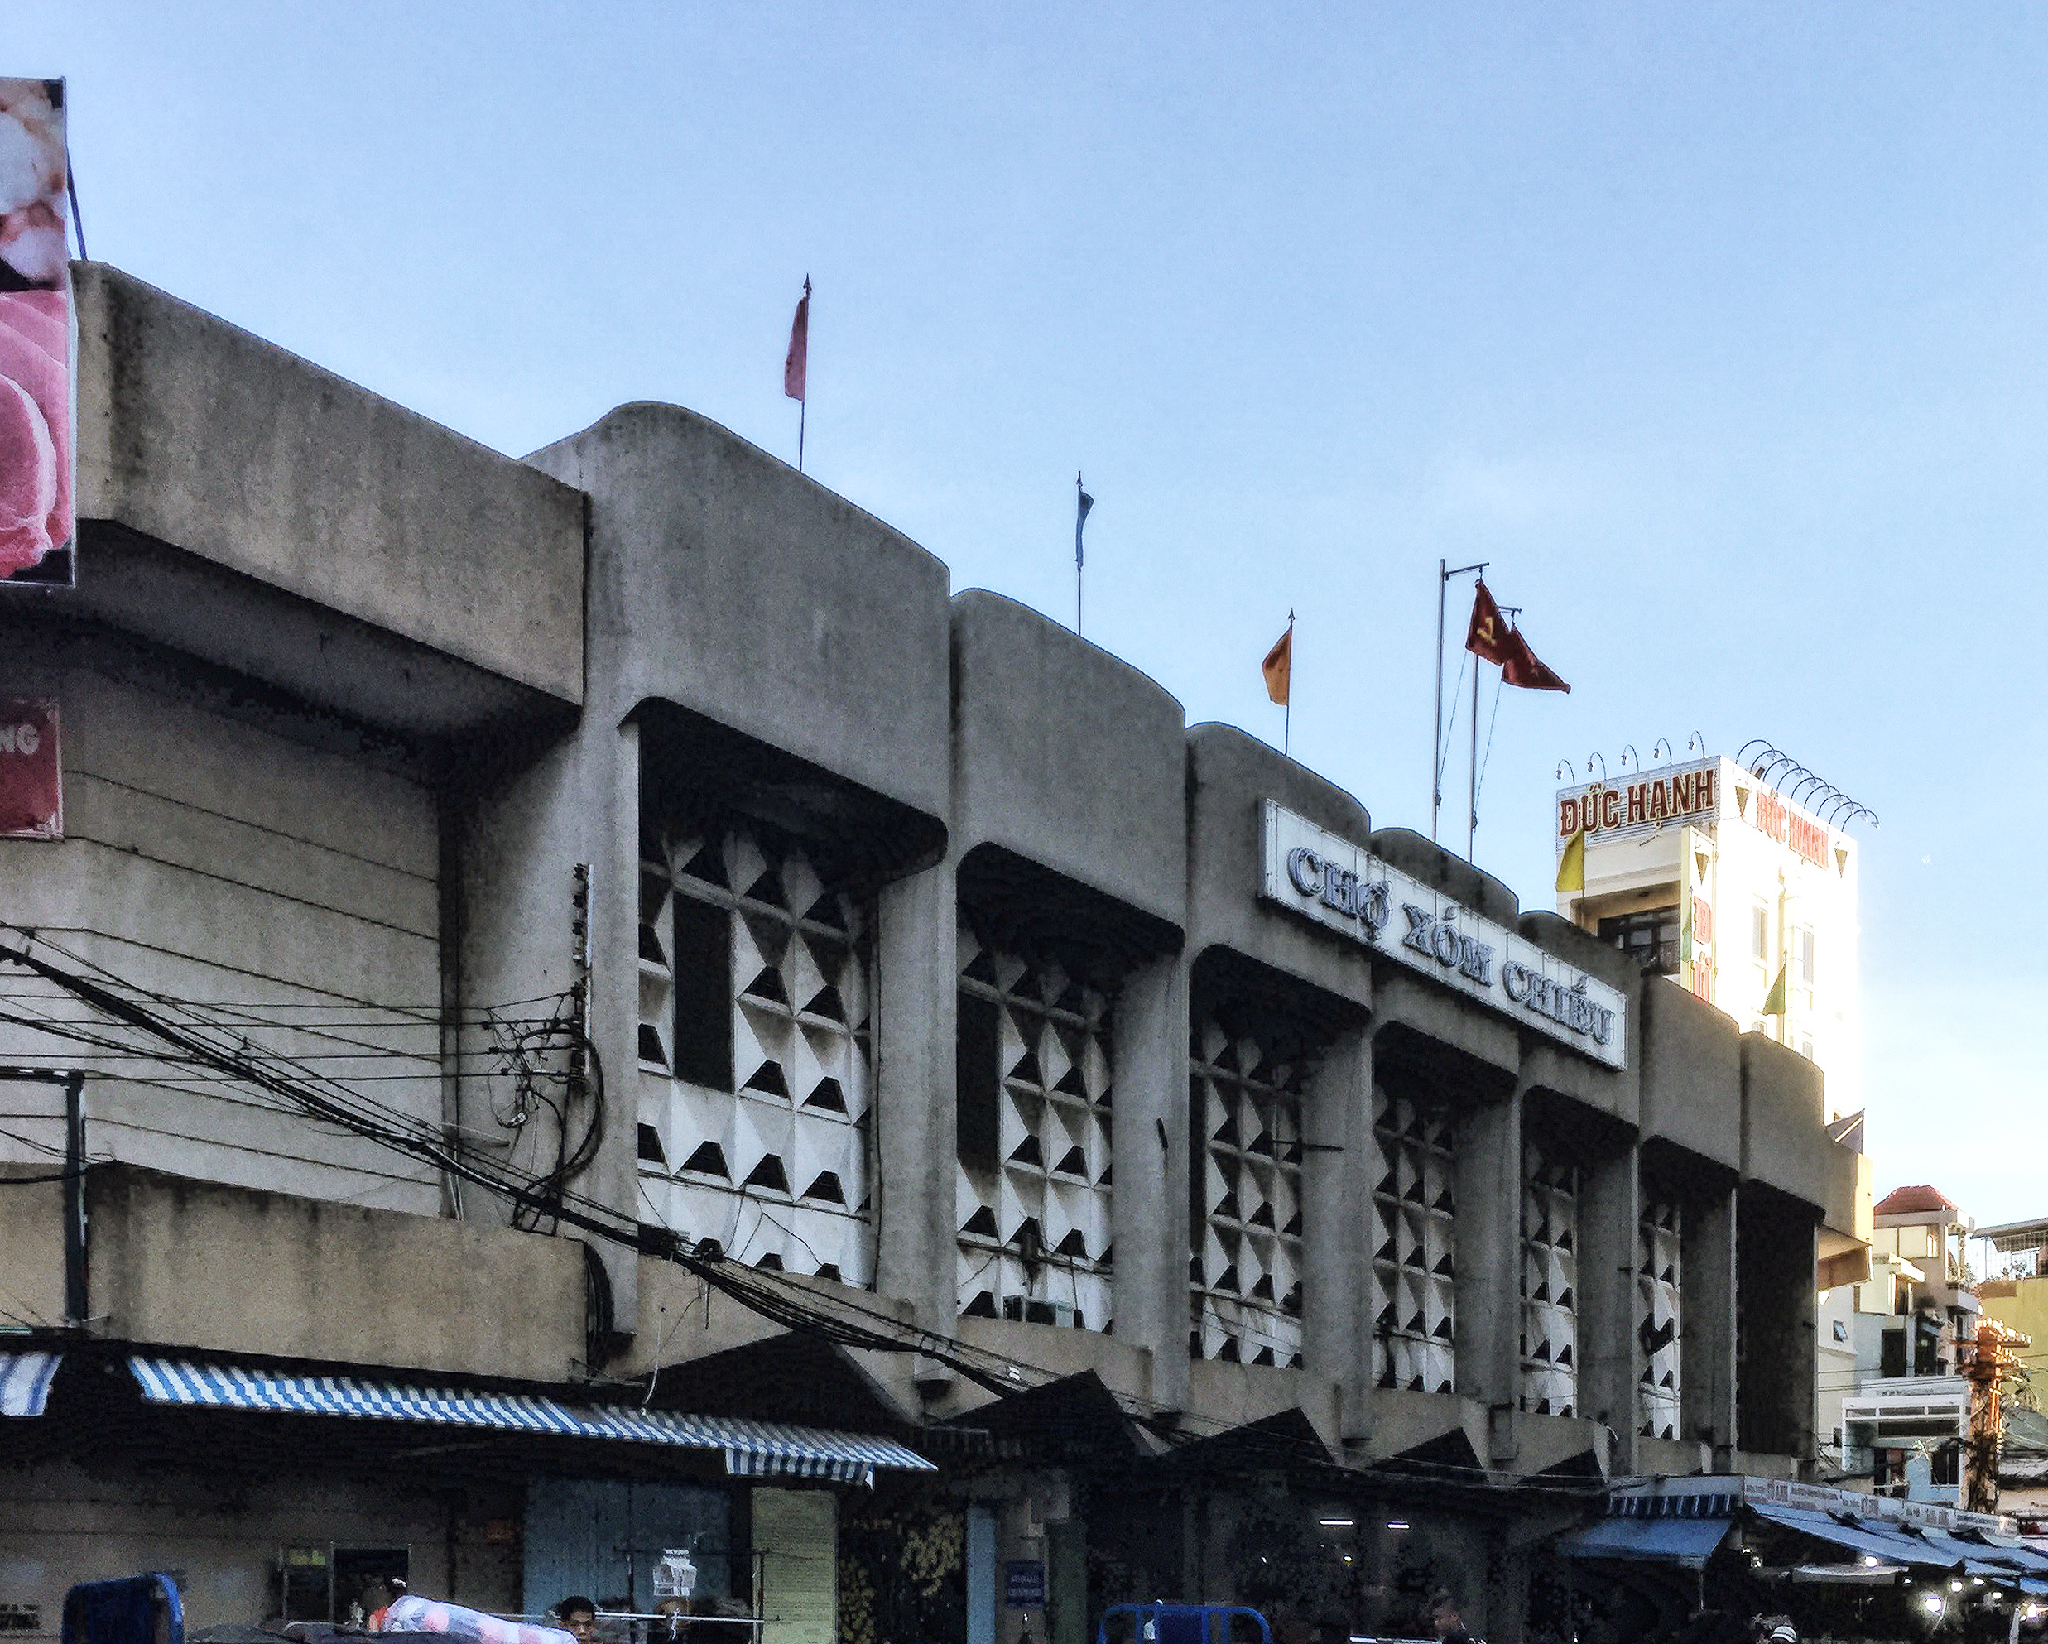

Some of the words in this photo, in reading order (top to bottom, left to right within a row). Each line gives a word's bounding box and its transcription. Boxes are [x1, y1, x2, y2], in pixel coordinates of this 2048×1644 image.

[1560, 784, 1621, 837] ĐỨC
[1627, 769, 1716, 830] HẠNH
[1287, 846, 1392, 941] CHỢ
[1402, 904, 1496, 988] XÓM
[1502, 961, 1615, 1046] CHIẾU
